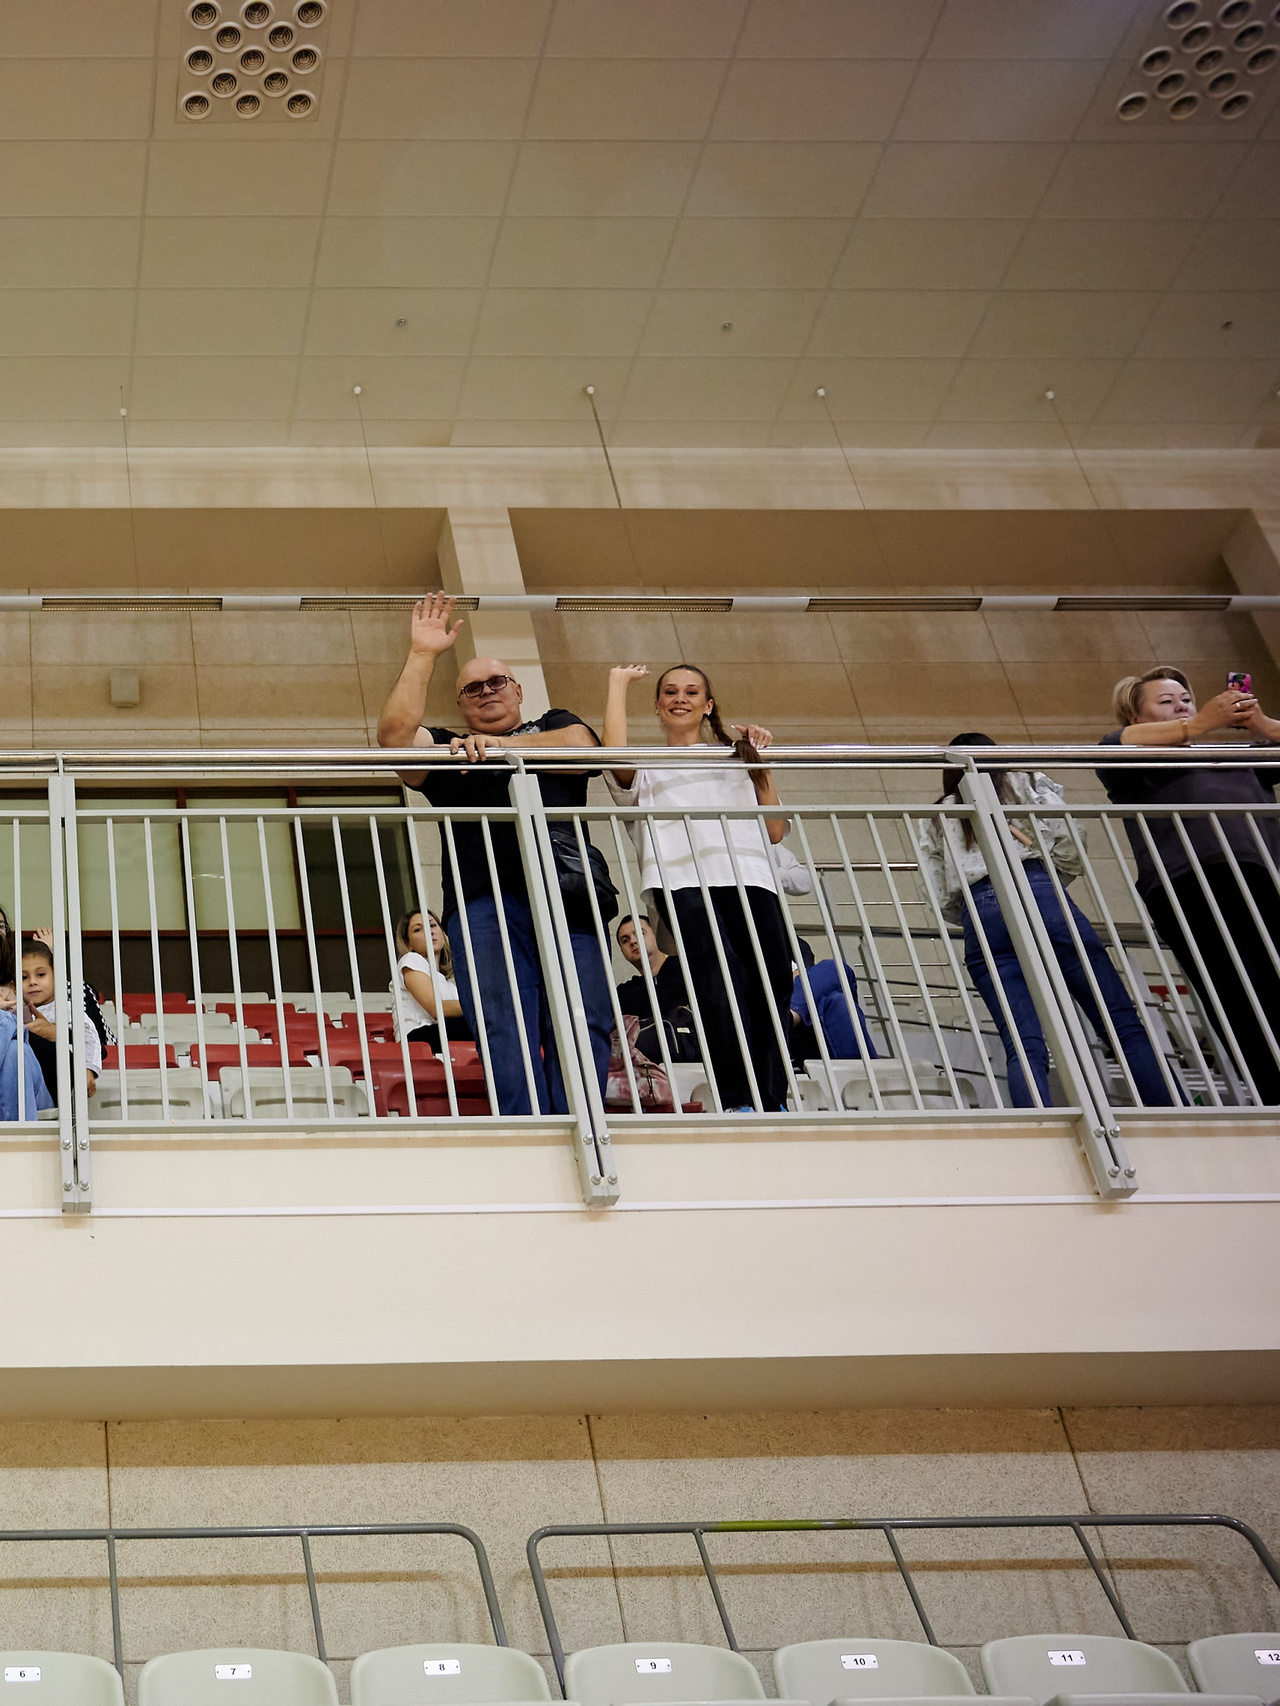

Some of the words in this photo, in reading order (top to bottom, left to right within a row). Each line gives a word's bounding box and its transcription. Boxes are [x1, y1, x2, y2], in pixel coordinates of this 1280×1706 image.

[853, 1657, 866, 1666] 10
[1061, 1653, 1074, 1662] 11
[1268, 1653, 1280, 1662] 12
[439, 1663, 446, 1671] 8
[650, 1661, 657, 1670] 9
[19, 1670, 26, 1678] 6
[230, 1668, 237, 1676] 7
